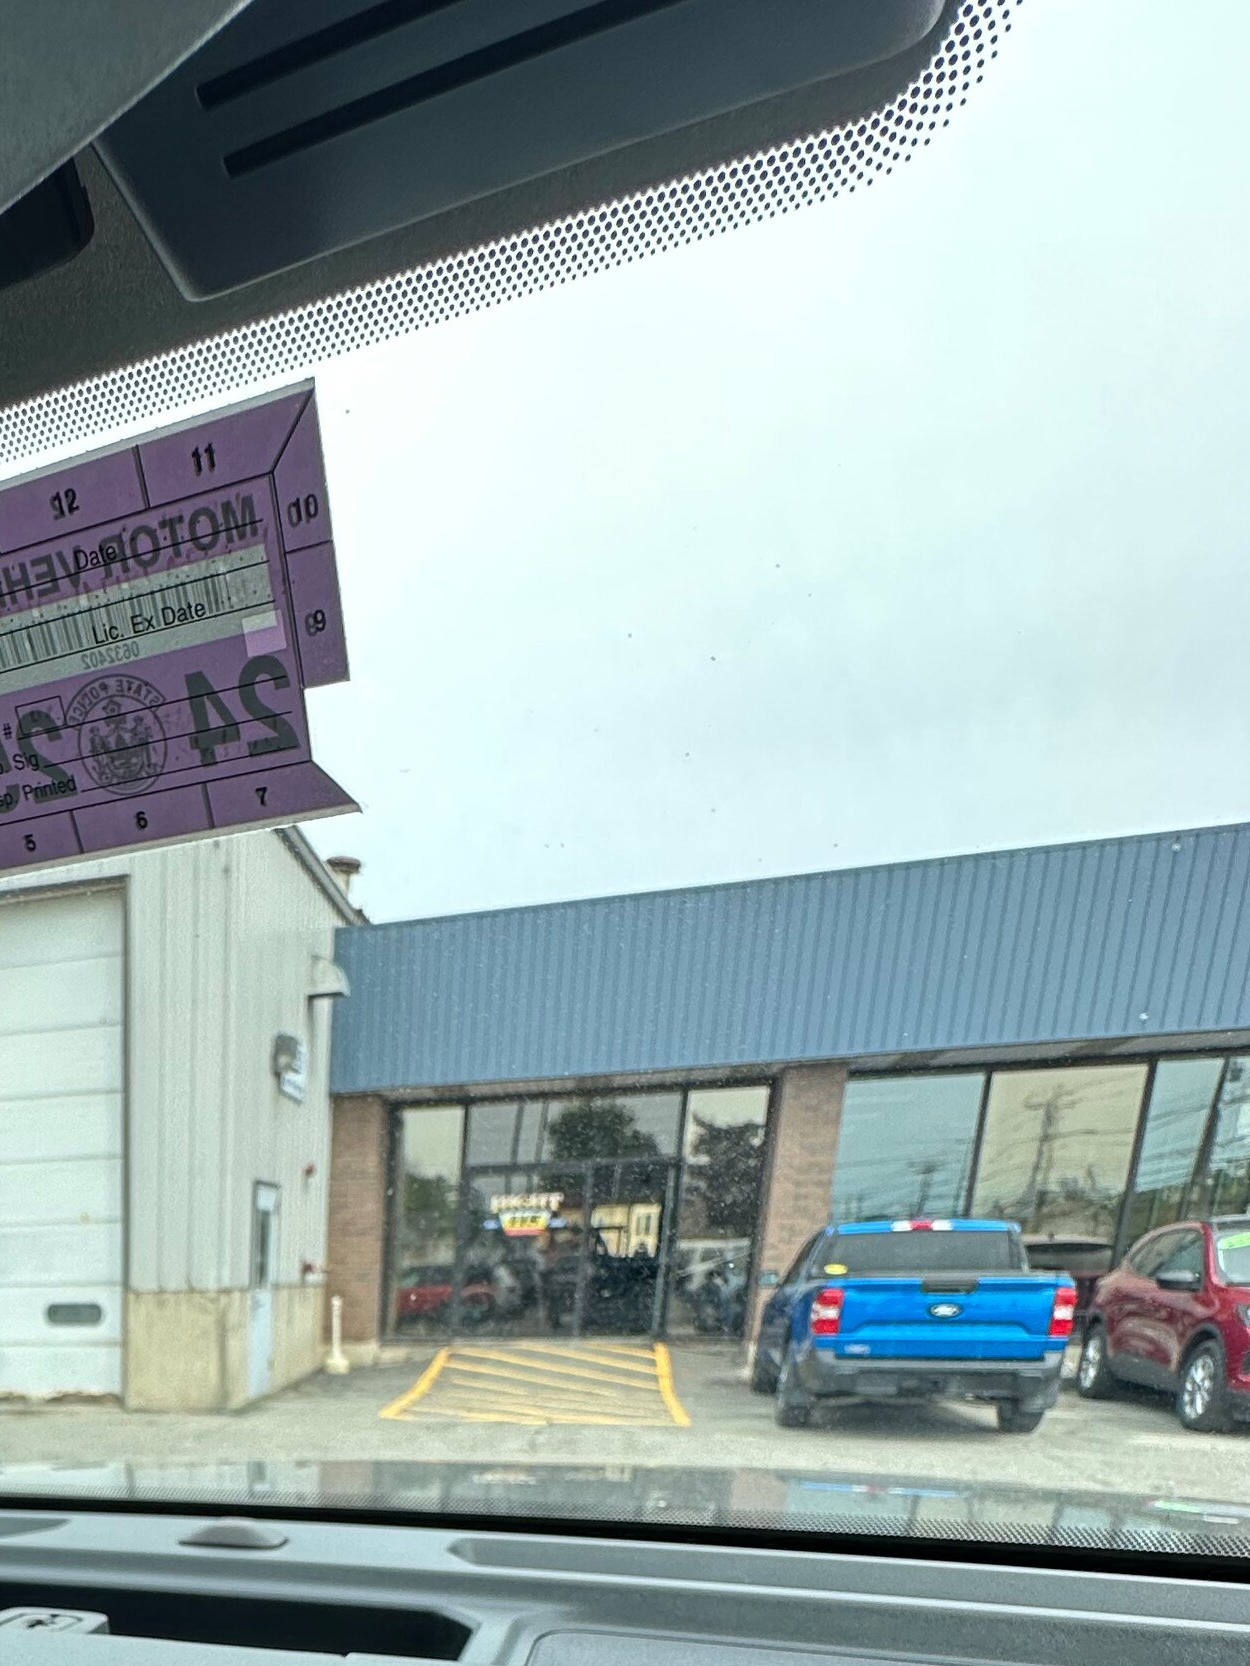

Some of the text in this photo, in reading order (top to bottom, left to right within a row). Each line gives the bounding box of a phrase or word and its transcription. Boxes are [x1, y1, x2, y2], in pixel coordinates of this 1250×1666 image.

[192, 443, 216, 476] 11
[50, 488, 79, 521] 12
[75, 543, 118, 570] Date
[92, 623, 124, 644] Lic.
[131, 614, 155, 633] Ex
[161, 602, 206, 626] Date
[22, 775, 77, 800] Printed
[255, 787, 267, 806] 7
[135, 811, 148, 829] 6
[24, 834, 37, 852] 5
